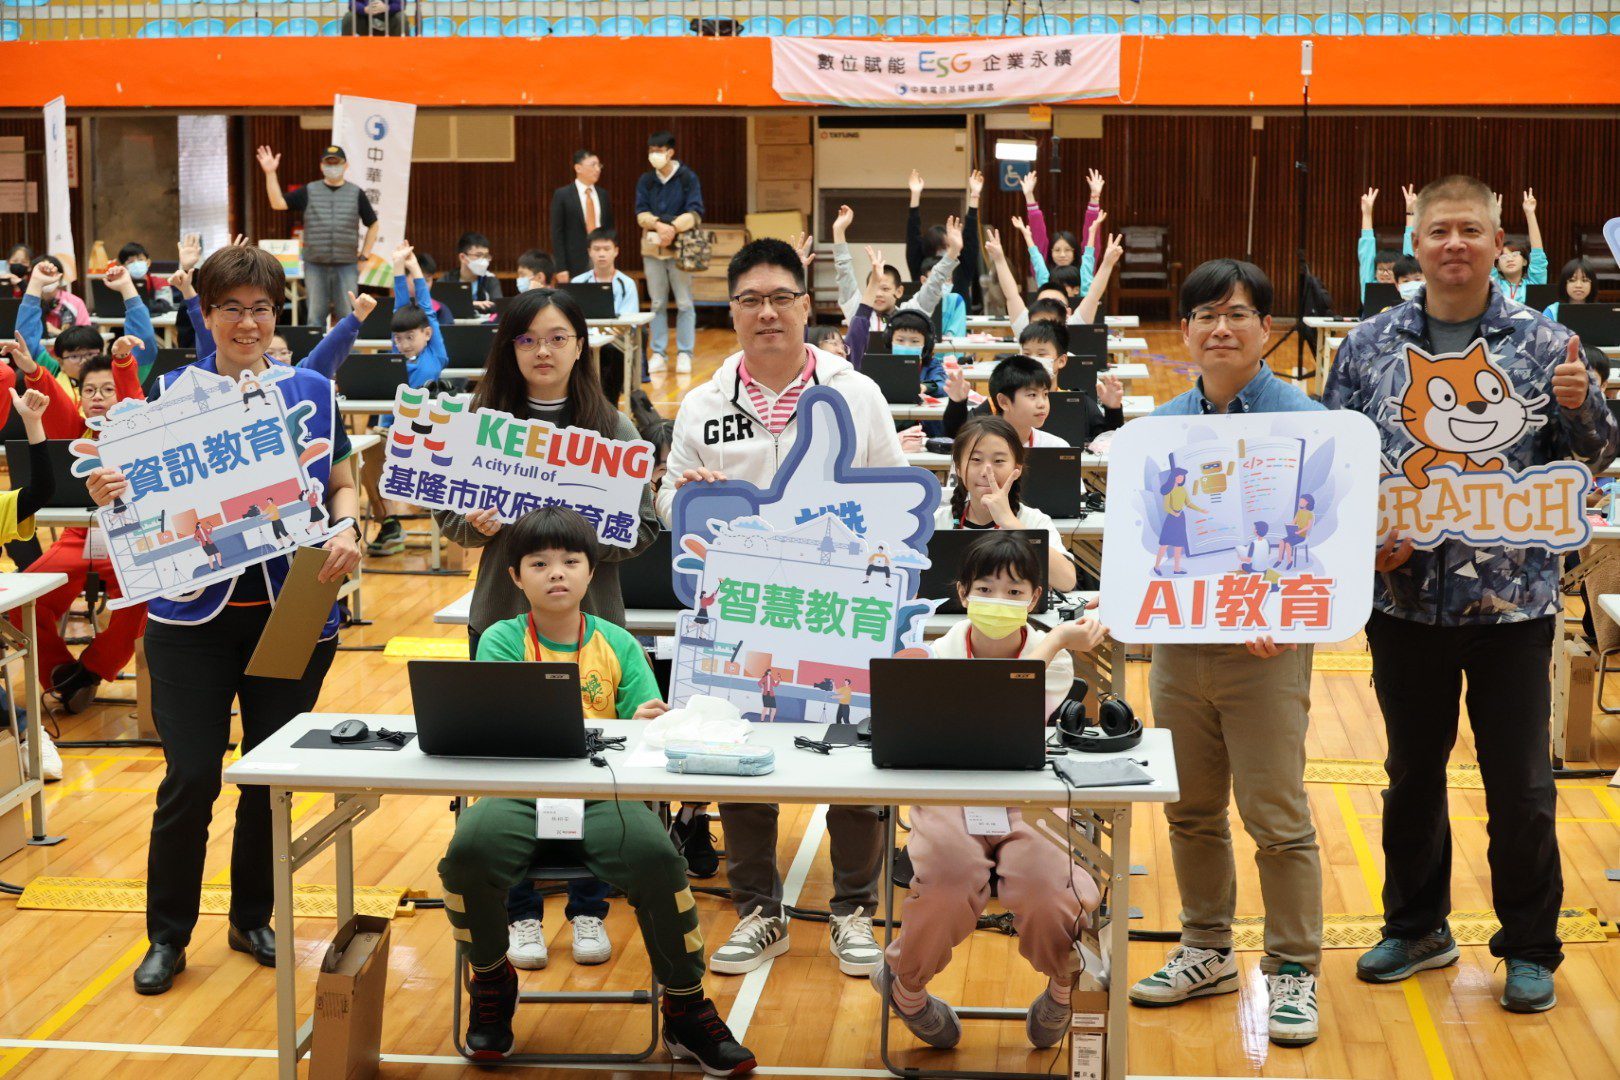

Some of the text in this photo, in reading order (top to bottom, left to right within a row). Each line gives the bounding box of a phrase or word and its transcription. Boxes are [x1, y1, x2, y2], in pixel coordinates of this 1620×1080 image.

[817, 49, 1073, 78] 數位賦能 ESG 企業永續
[120, 416, 287, 502] 資訊教育
[472, 456, 558, 483] A city full of
[476, 414, 649, 478] KEELUNG
[717, 577, 893, 642] 智慧教育
[1135, 573, 1333, 627] AI教育
